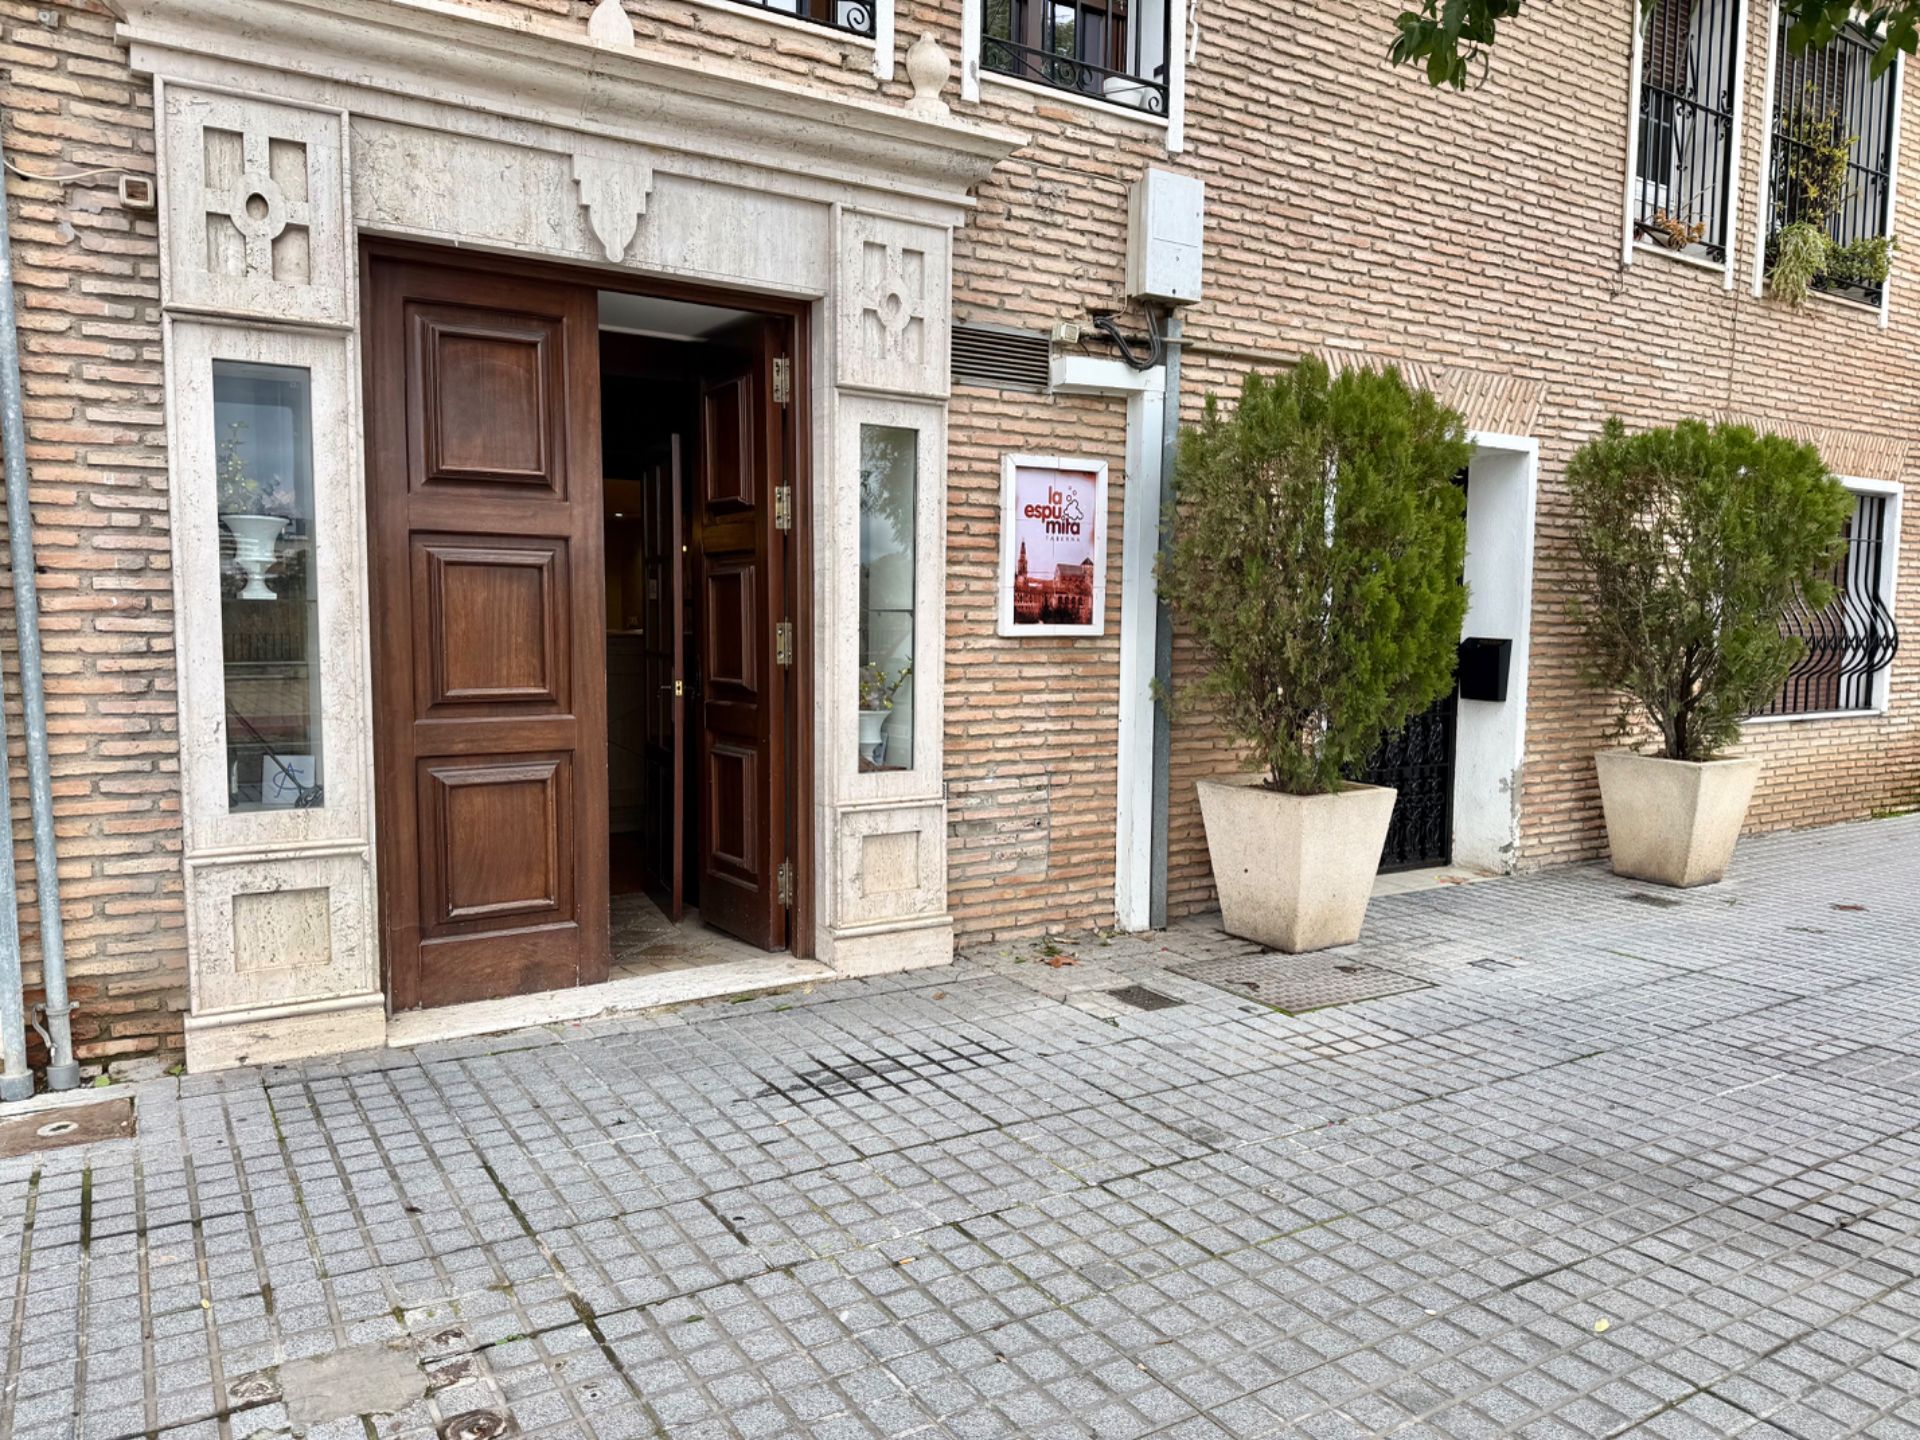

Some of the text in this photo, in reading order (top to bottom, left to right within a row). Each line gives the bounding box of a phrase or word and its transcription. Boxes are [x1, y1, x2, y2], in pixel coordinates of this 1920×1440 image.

[1048, 485, 1062, 505] la
[1024, 504, 1062, 523] espu
[1046, 517, 1080, 535] mita
